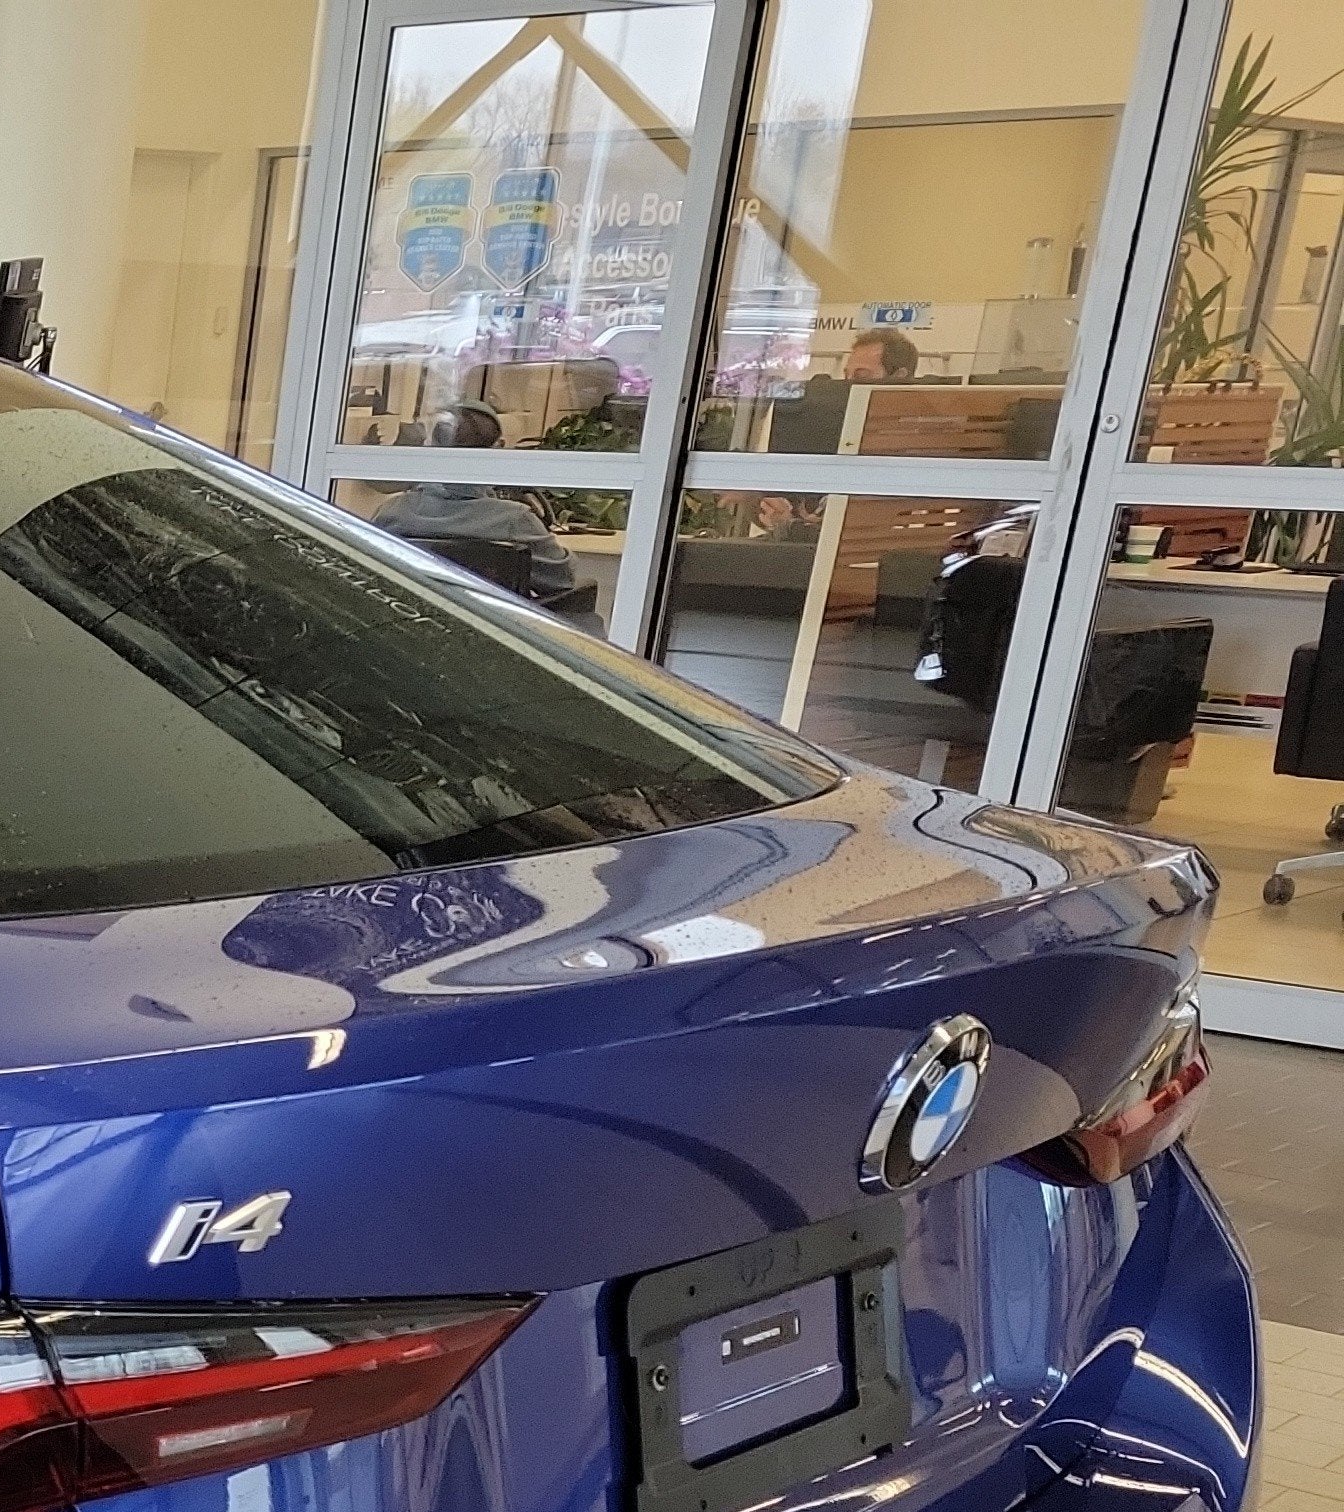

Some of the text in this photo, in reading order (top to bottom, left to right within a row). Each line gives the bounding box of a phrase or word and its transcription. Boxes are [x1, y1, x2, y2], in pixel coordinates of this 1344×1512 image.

[862, 301, 933, 310] AUTOMATIC DOOR
[148, 1190, 293, 1265] i4
